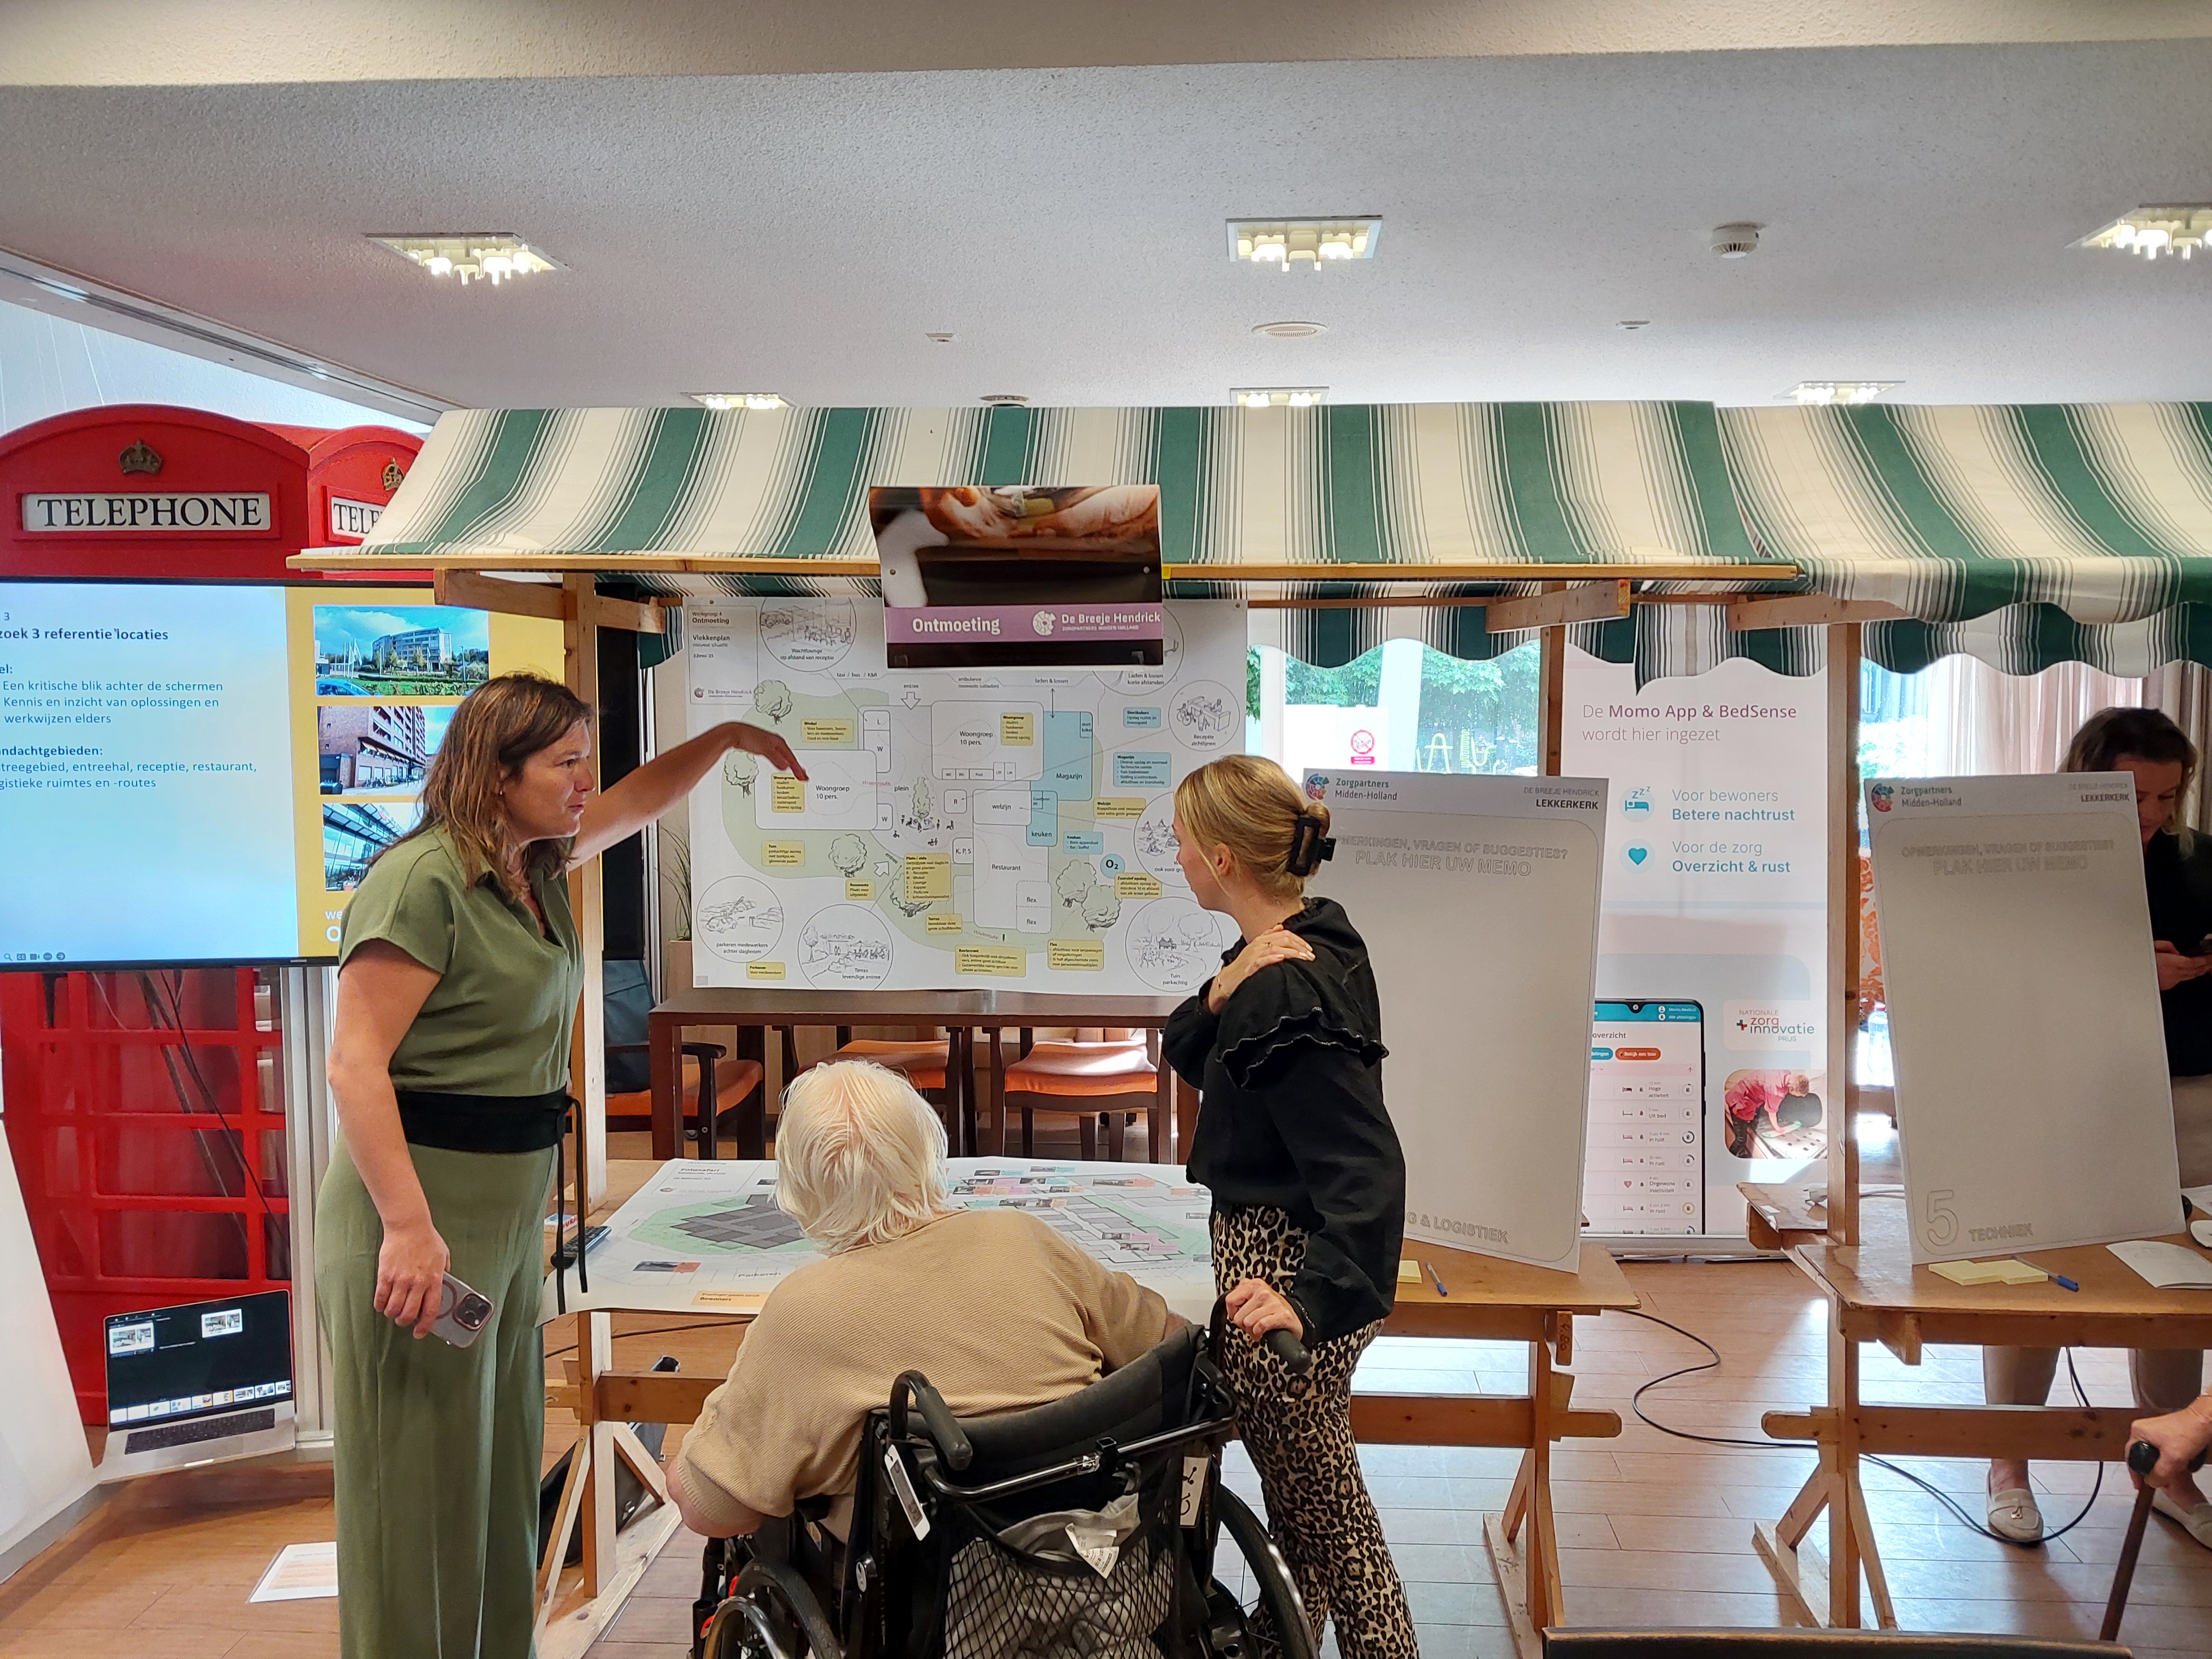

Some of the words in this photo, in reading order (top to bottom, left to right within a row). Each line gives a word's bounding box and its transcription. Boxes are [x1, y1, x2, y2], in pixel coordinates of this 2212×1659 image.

[37, 498, 261, 527] TELEPHONE
[333, 503, 383, 535] TELE
[4, 612, 10, 621] 3
[1062, 613, 1076, 625] De
[1114, 612, 1161, 623] Hendrick
[912, 617, 1000, 635] Ontmoeting
[32, 628, 40, 639] 3
[45, 627, 112, 640] referentie
[116, 628, 169, 640] locaties
[3, 681, 24, 691] Een
[28, 680, 78, 691] kritische
[82, 680, 102, 691] blik
[106, 680, 143, 691] achter
[147, 680, 162, 691] de
[165, 680, 223, 691] schermen
[4, 697, 42, 707] Kennis
[46, 699, 60, 707] en
[65, 696, 102, 707] inzicht
[107, 699, 127, 707] van
[131, 696, 201, 709] oplossingen
[205, 699, 219, 707] en
[4, 713, 71, 725] werkwijzen
[75, 712, 111, 723] elders
[1583, 704, 1603, 718] De
[1609, 705, 1660, 718] Momo
[1665, 705, 1697, 721] App
[1702, 705, 1714, 718] &
[1719, 704, 1797, 718] BedSense
[1582, 727, 1628, 741] wordt
[1632, 726, 1661, 741] hier
[1666, 727, 1720, 744] ingezet
[0, 745, 103, 757] ndachtgebieden:
[73, 761, 133, 774] entreehal,
[137, 761, 189, 774] receptie,
[193, 761, 257, 774] restaurant,
[47, 777, 92, 788] ruimtes
[95, 780, 110, 788] en
[113, 779, 156, 788] -routes
[1336, 778, 1389, 789] Zorgpartners
[1335, 790, 1397, 801] Midden-Holland
[1563, 788, 1599, 796] HENDRICK
[1672, 789, 1705, 802] Voor
[1709, 789, 1779, 802] bewoners
[1901, 786, 1952, 796] Zorgpartners
[2081, 793, 2130, 802] LEKKERKERK
[1536, 799, 1599, 810] LEKKERKERK
[1901, 797, 1962, 807] Midden-Holland
[1672, 809, 1720, 821] Betere
[1725, 808, 1795, 821] nachtrust
[1413, 840, 1462, 853] VRAGEN
[1464, 843, 1481, 853] OF
[1483, 844, 1568, 859] SUGGESTIES?
[1672, 840, 1705, 854] Voor
[1709, 840, 1727, 854] de
[1732, 843, 1763, 856] zorg
[1355, 850, 1398, 867] PLAK
[1402, 853, 1441, 870] HIER
[1445, 857, 1472, 872] UW
[1478, 859, 1532, 876] MEMO
[1672, 860, 1744, 873] Overzicht
[1748, 860, 1758, 872] &
[1762, 861, 1791, 873] rust
[1750, 1017, 1779, 1028] zorg
[1750, 1023, 1815, 1034] innovatie
[1926, 1189, 1959, 1246] 5
[1969, 1223, 2034, 1243] TECHNIEK
[1420, 1214, 1430, 1227] &
[1433, 1216, 1508, 1243] LOGISTIEK
